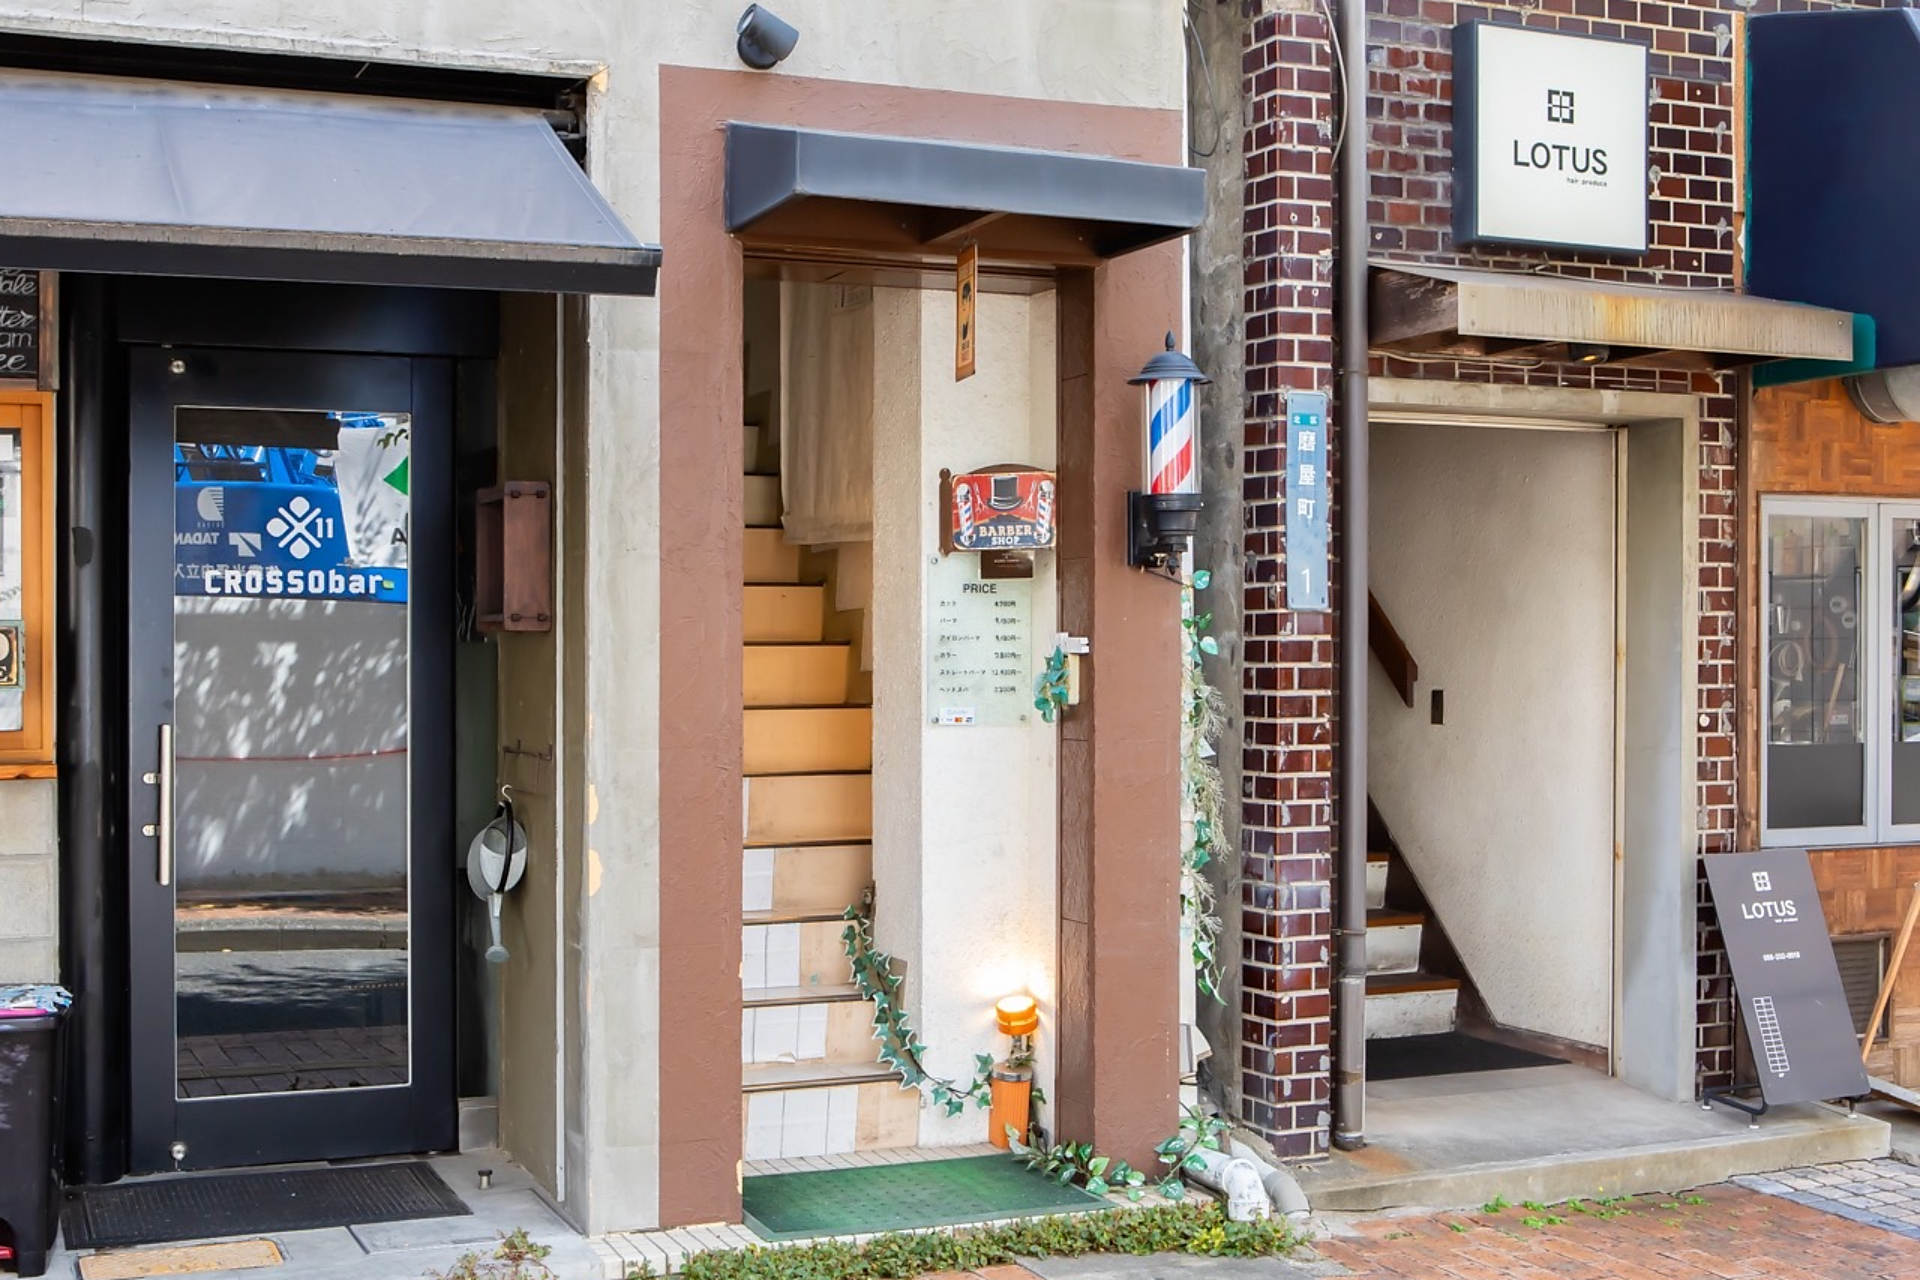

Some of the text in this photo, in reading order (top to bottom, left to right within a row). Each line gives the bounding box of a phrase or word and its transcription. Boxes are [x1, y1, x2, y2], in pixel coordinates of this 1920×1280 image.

[1513, 139, 1608, 176] LOTUS
[0, 273, 36, 295] ale
[979, 524, 1033, 537] BARBER
[991, 535, 1020, 547] SHOP
[962, 583, 998, 594] PRICE
[1301, 568, 1311, 595] 1
[1741, 900, 1797, 919] LOTUS
